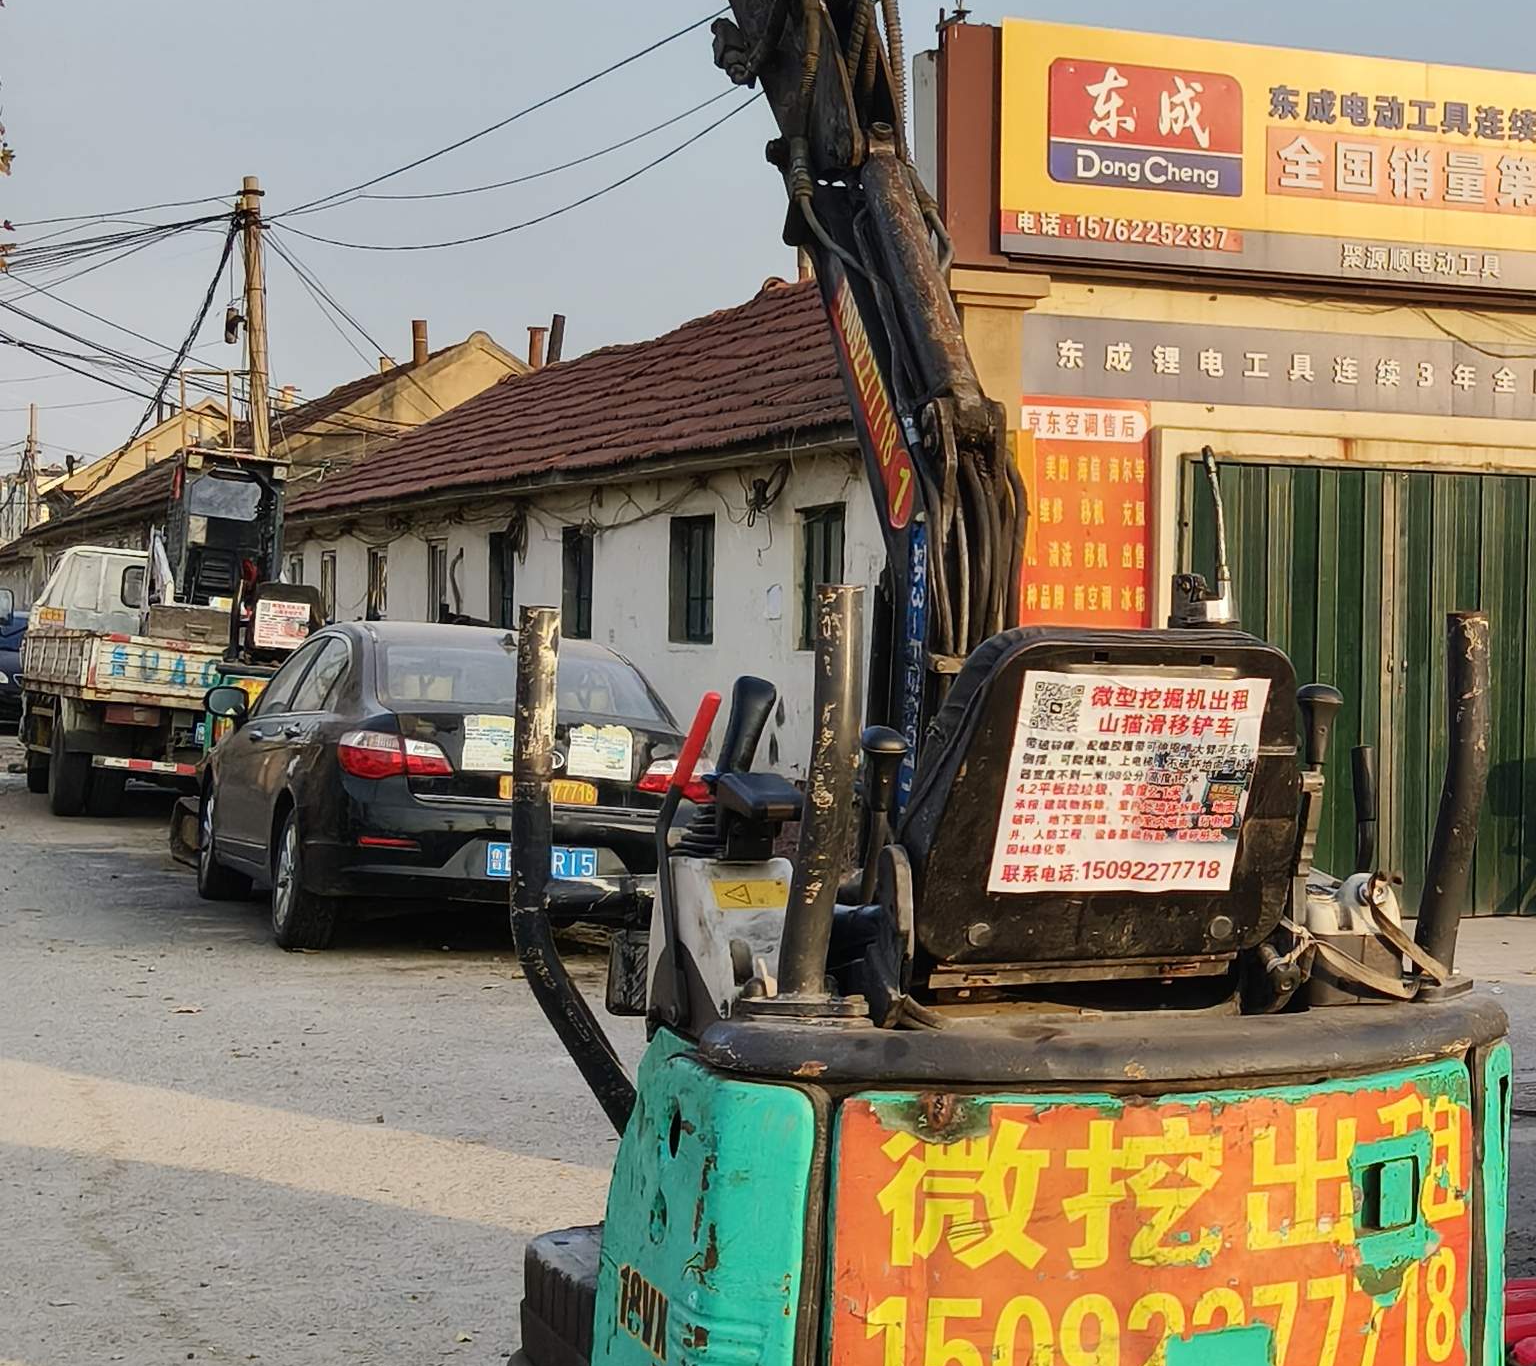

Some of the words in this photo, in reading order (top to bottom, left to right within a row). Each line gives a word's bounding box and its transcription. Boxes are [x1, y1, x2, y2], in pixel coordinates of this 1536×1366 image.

[1084, 66, 1210, 149] 东成
[1341, 243, 1502, 279] 聚源顺电动工具
[1027, 409, 1135, 438] 京东空调售后
[1121, 542, 1145, 570] 出售
[1073, 584, 1113, 612] 新空调
[1090, 686, 1250, 712] 微型挖掘机出租
[1098, 713, 1236, 738] 山猫滑移铲车
